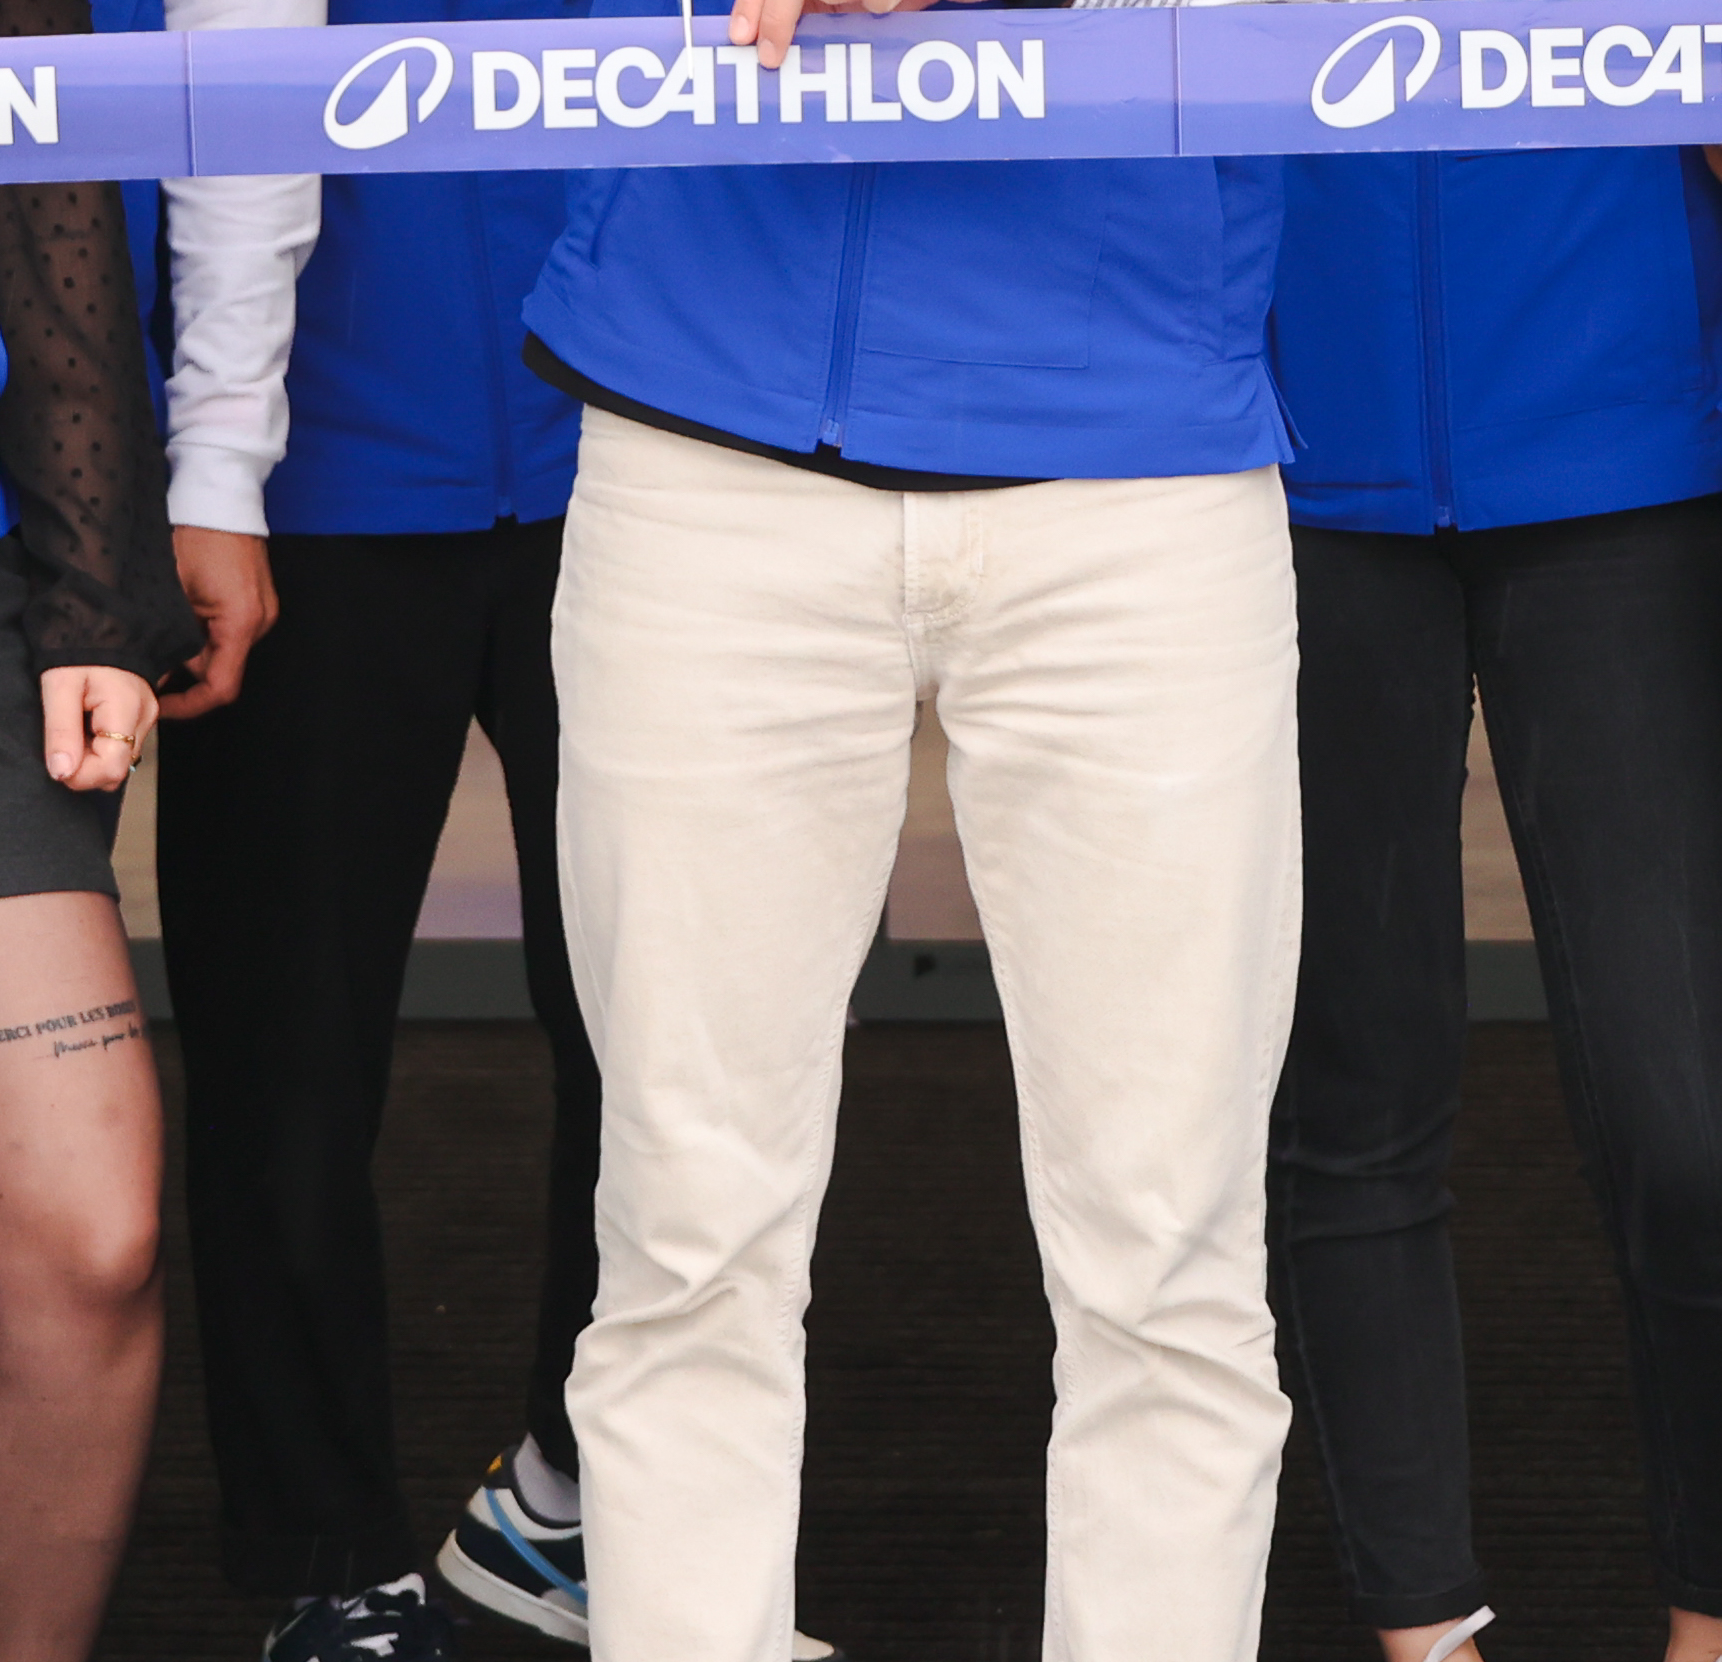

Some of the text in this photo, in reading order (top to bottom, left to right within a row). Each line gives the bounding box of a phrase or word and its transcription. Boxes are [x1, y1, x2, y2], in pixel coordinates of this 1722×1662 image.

[471, 38, 1046, 131] DECATHLON
[35, 1014, 78, 1035] POUR
[79, 1007, 105, 1024] LES
